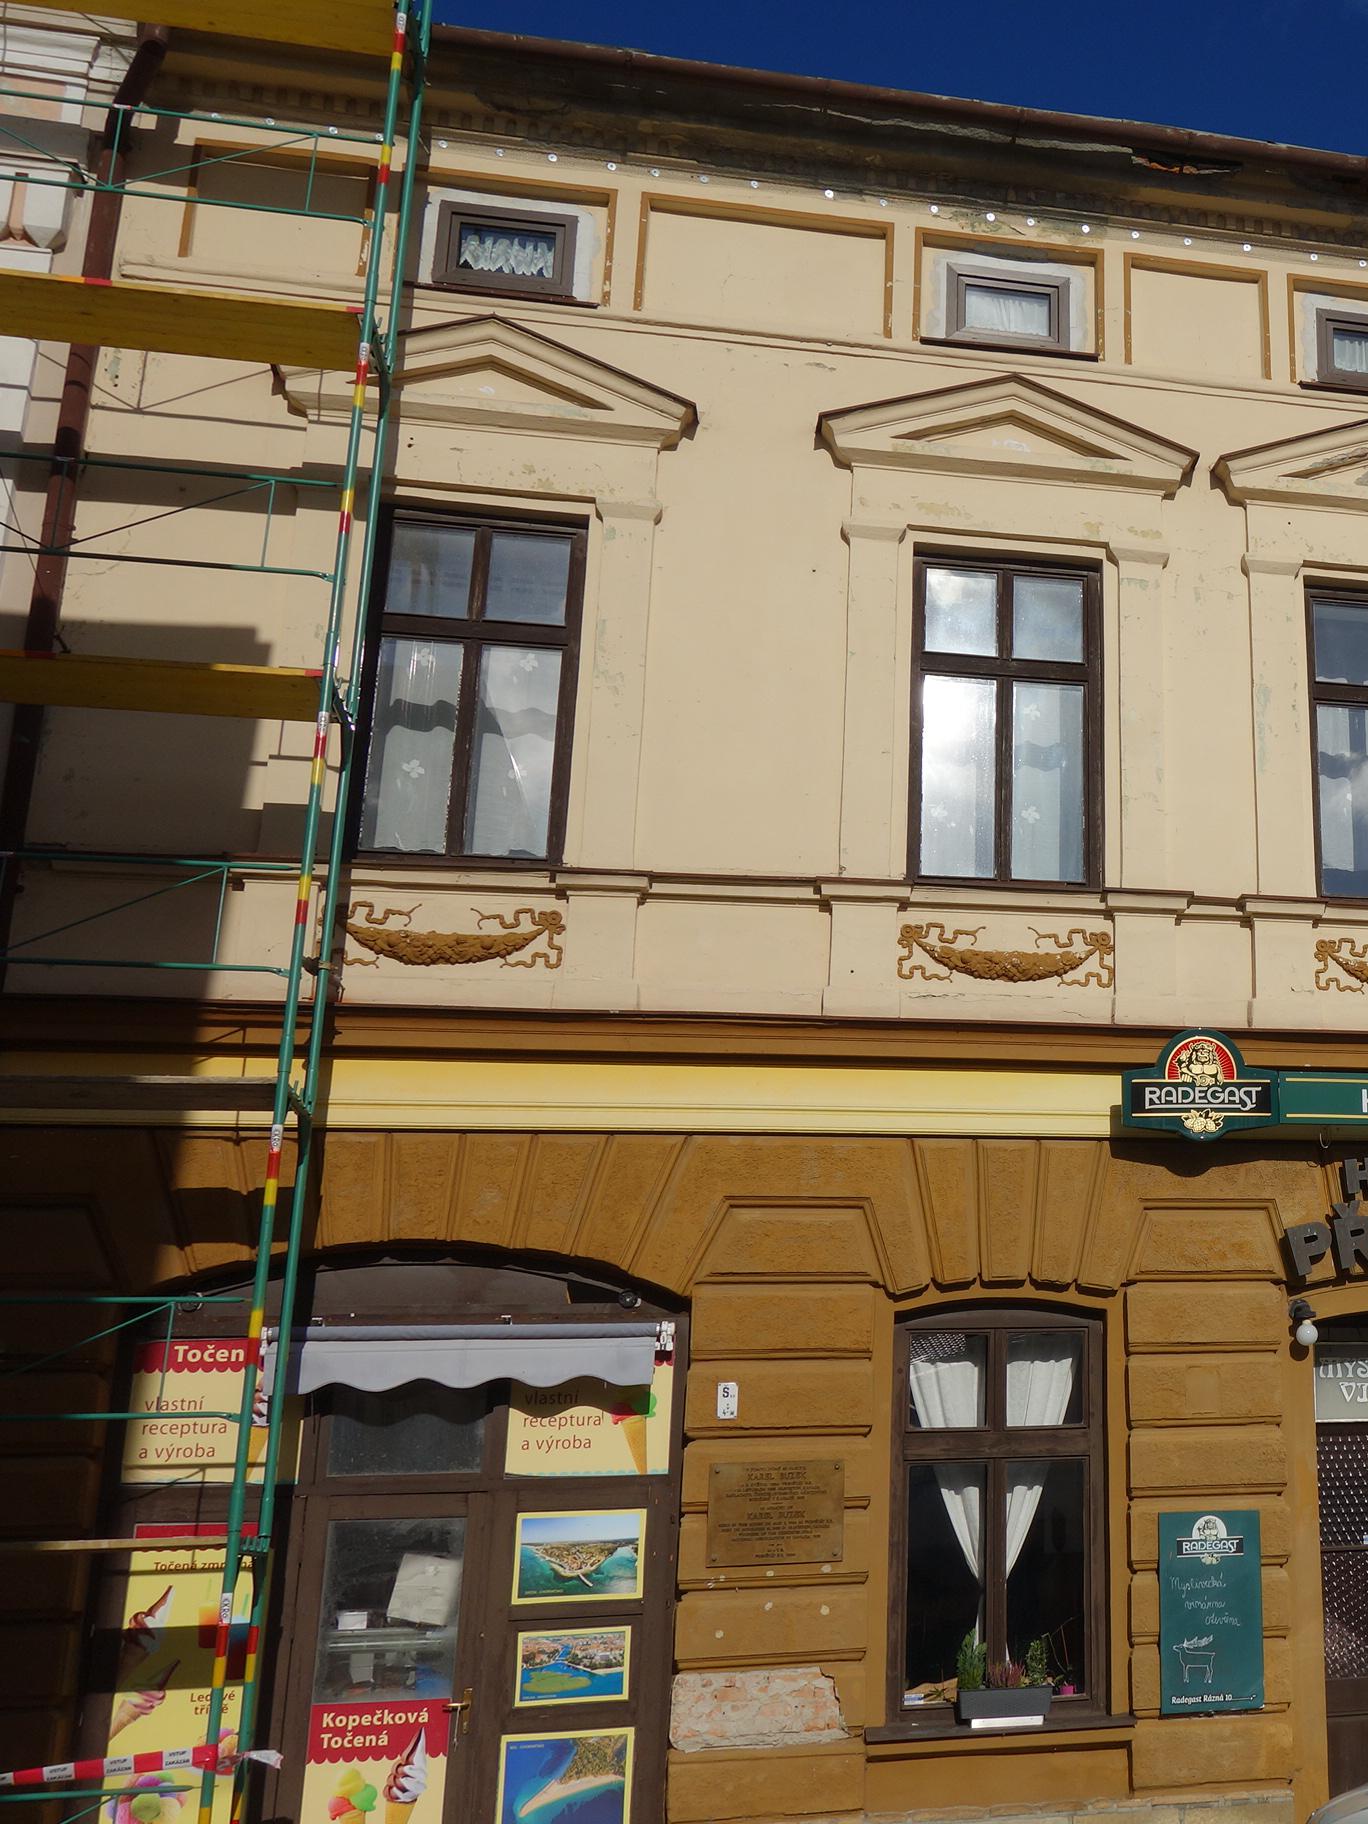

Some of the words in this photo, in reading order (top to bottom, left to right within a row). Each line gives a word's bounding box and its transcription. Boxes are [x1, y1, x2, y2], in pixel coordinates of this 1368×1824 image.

[1145, 1086, 1262, 1111] RADEGAST
[174, 1344, 245, 1363] Točen
[145, 1395, 205, 1412] vlastní
[525, 1389, 579, 1405] vlastní
[142, 1421, 227, 1438] receptura
[523, 1413, 601, 1430] receptura
[138, 1448, 148, 1459] a
[155, 1443, 216, 1462] výroba
[521, 1439, 530, 1450] a
[536, 1434, 592, 1454] výroba
[1182, 1539, 1240, 1554] RADEGAST
[1171, 1695, 1202, 1705] Radegast
[322, 1707, 429, 1730] Kopečková
[320, 1730, 389, 1749] Točená
